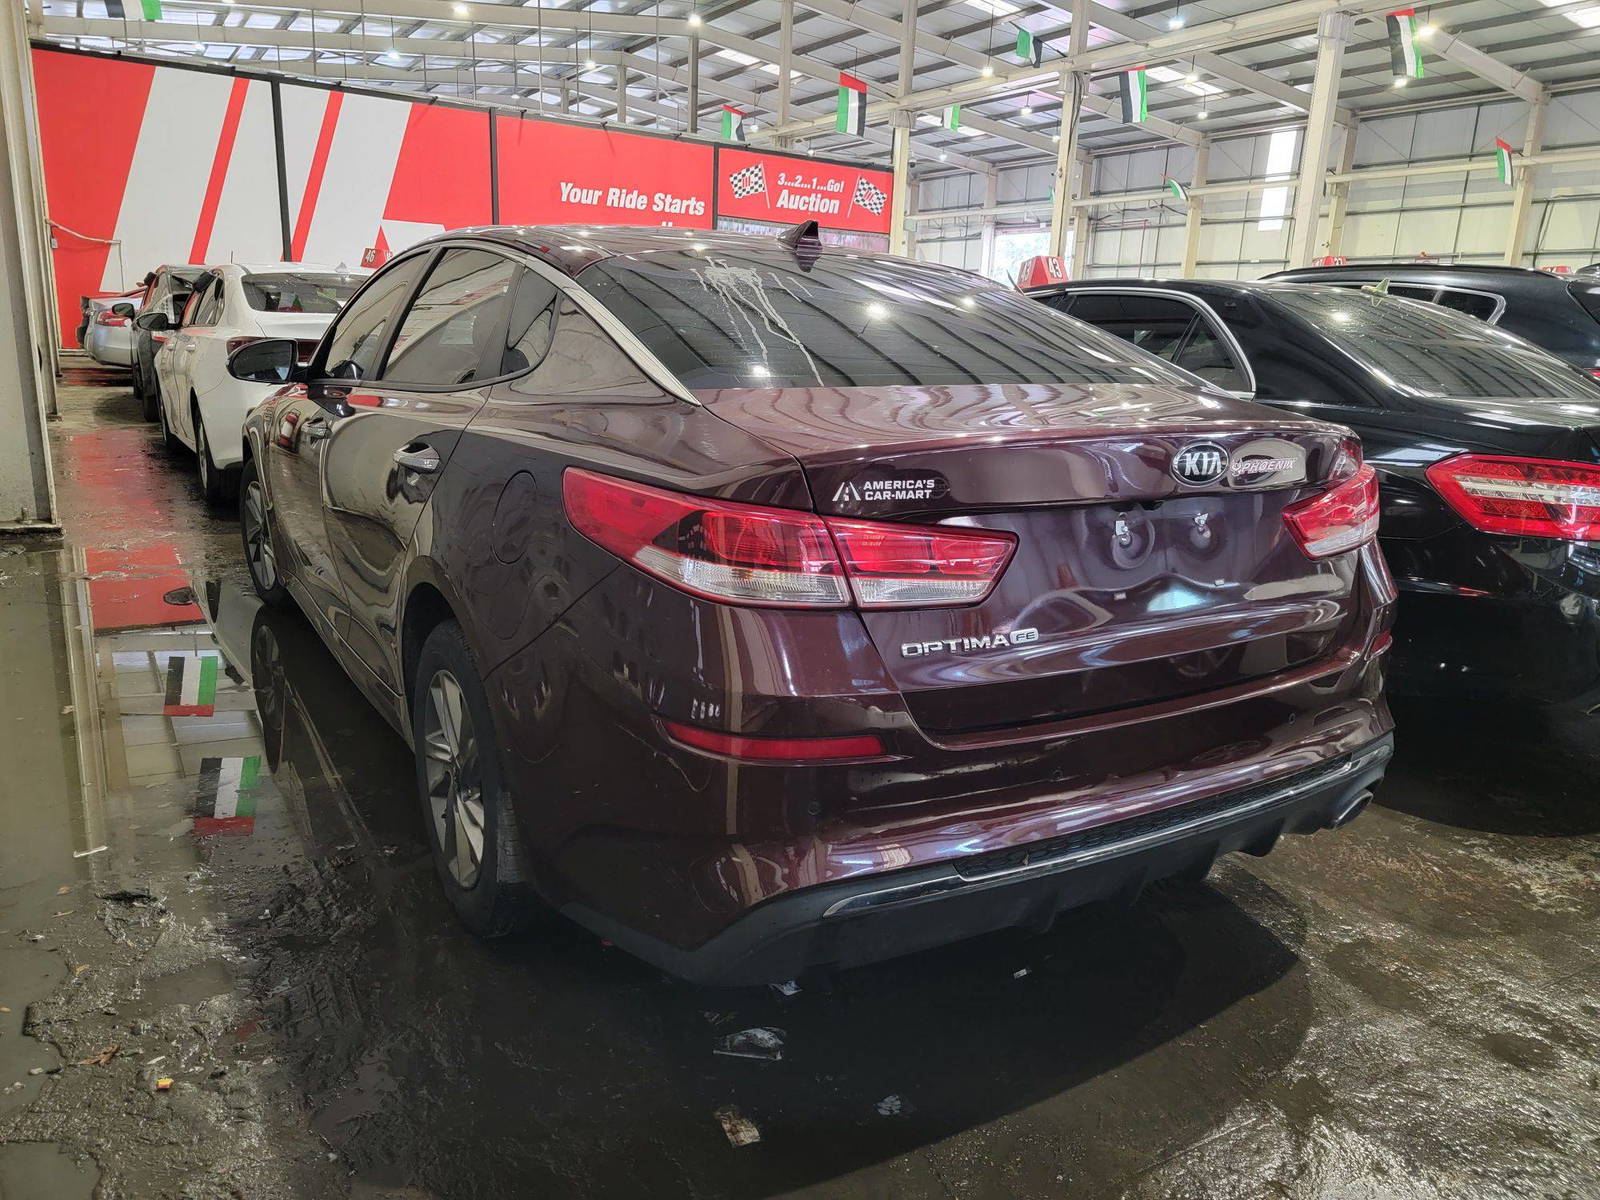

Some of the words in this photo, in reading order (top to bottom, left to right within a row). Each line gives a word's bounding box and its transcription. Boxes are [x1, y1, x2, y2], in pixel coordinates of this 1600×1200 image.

[559, 182, 602, 205] Your
[606, 187, 648, 210] Ride
[652, 192, 705, 216] Starts
[776, 189, 840, 214] Auction
[1048, 257, 1063, 280] 43
[1184, 451, 1221, 476] KIA
[1241, 457, 1299, 475] PHOENIX
[863, 479, 935, 490] AMERICA'S
[901, 634, 1010, 658] OPTIMA
[1016, 631, 1036, 642] FE
